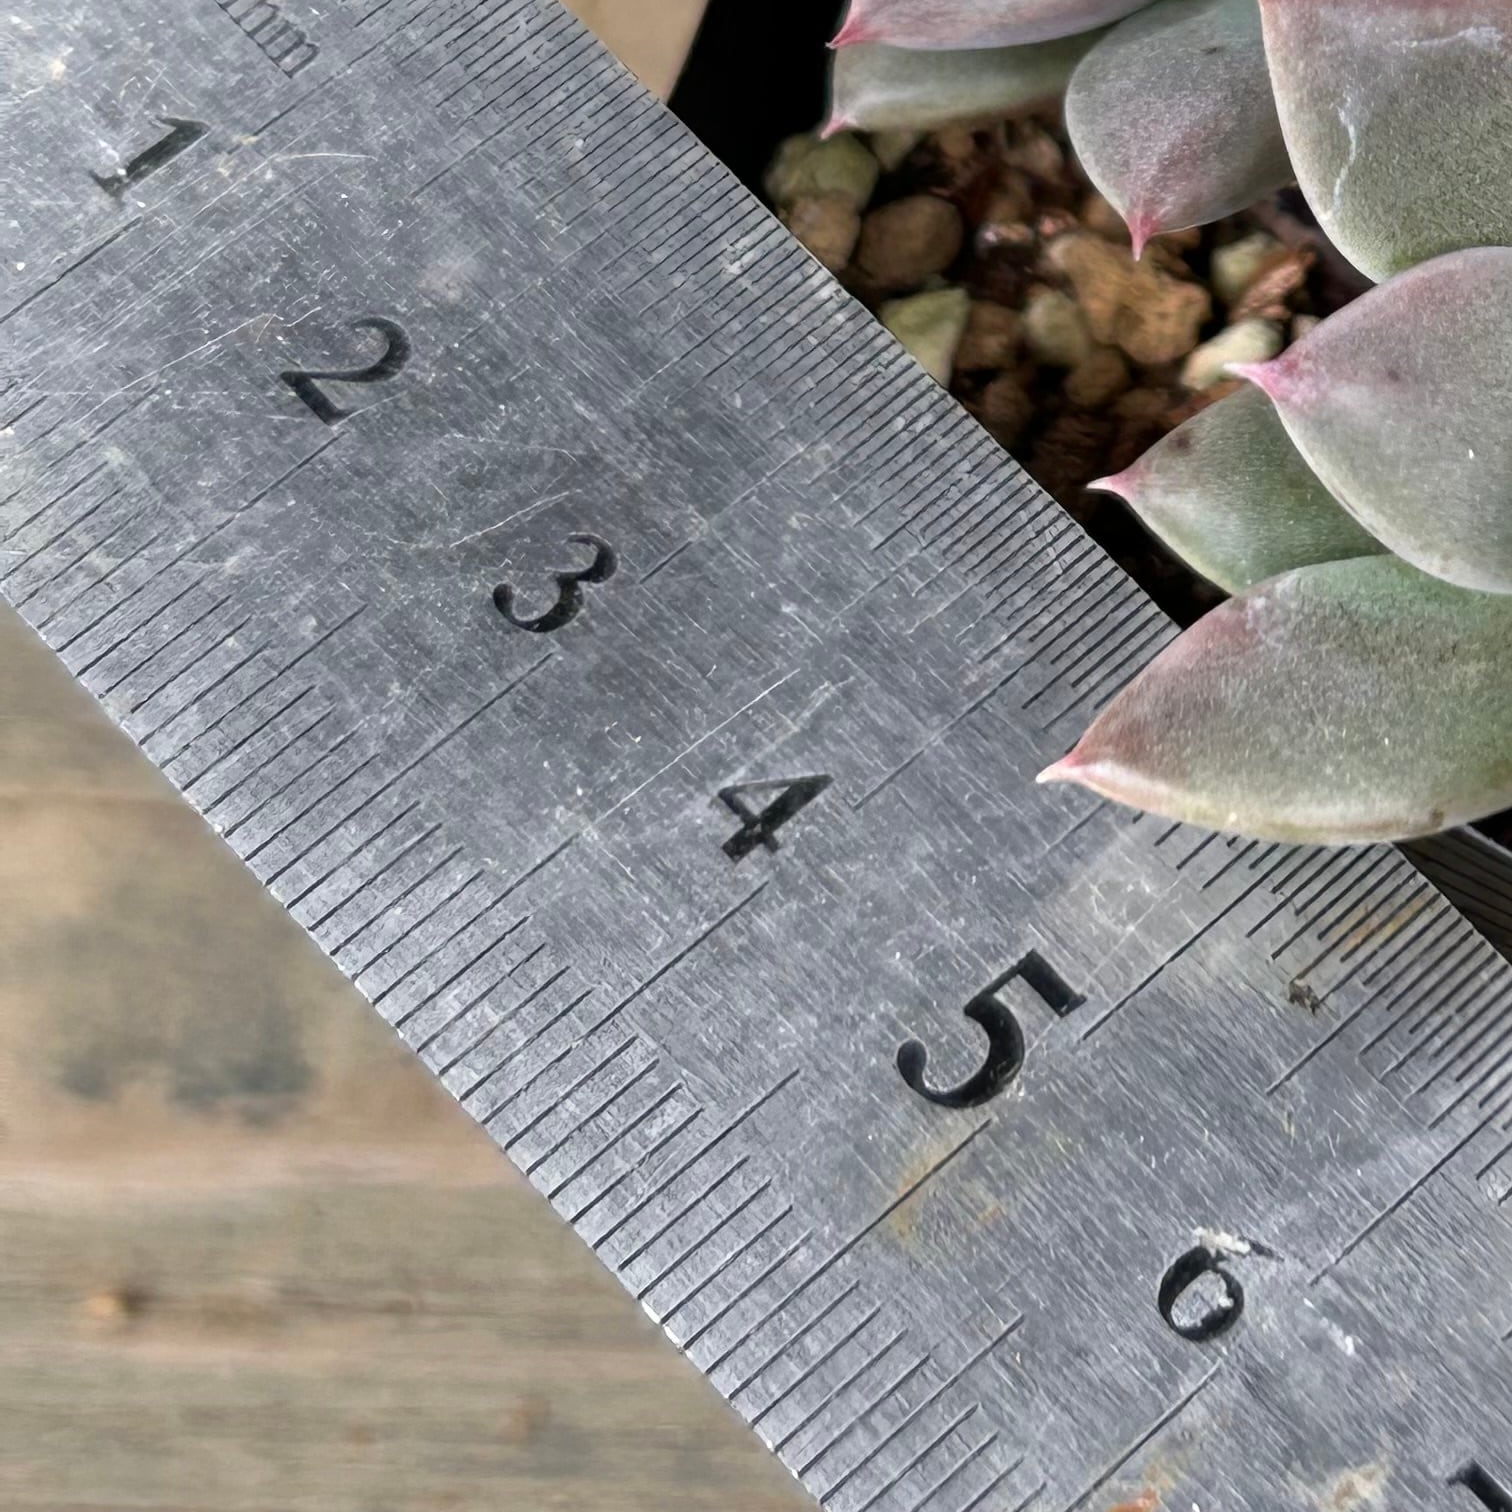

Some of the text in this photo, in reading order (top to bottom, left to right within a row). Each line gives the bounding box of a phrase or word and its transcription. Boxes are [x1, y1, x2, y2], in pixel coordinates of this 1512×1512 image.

[89, 114, 211, 200] 1
[279, 315, 412, 427] 2
[493, 532, 618, 634] 3
[714, 773, 834, 863] 4
[896, 948, 1088, 1109] 5
[1157, 1226, 1284, 1342] 6
